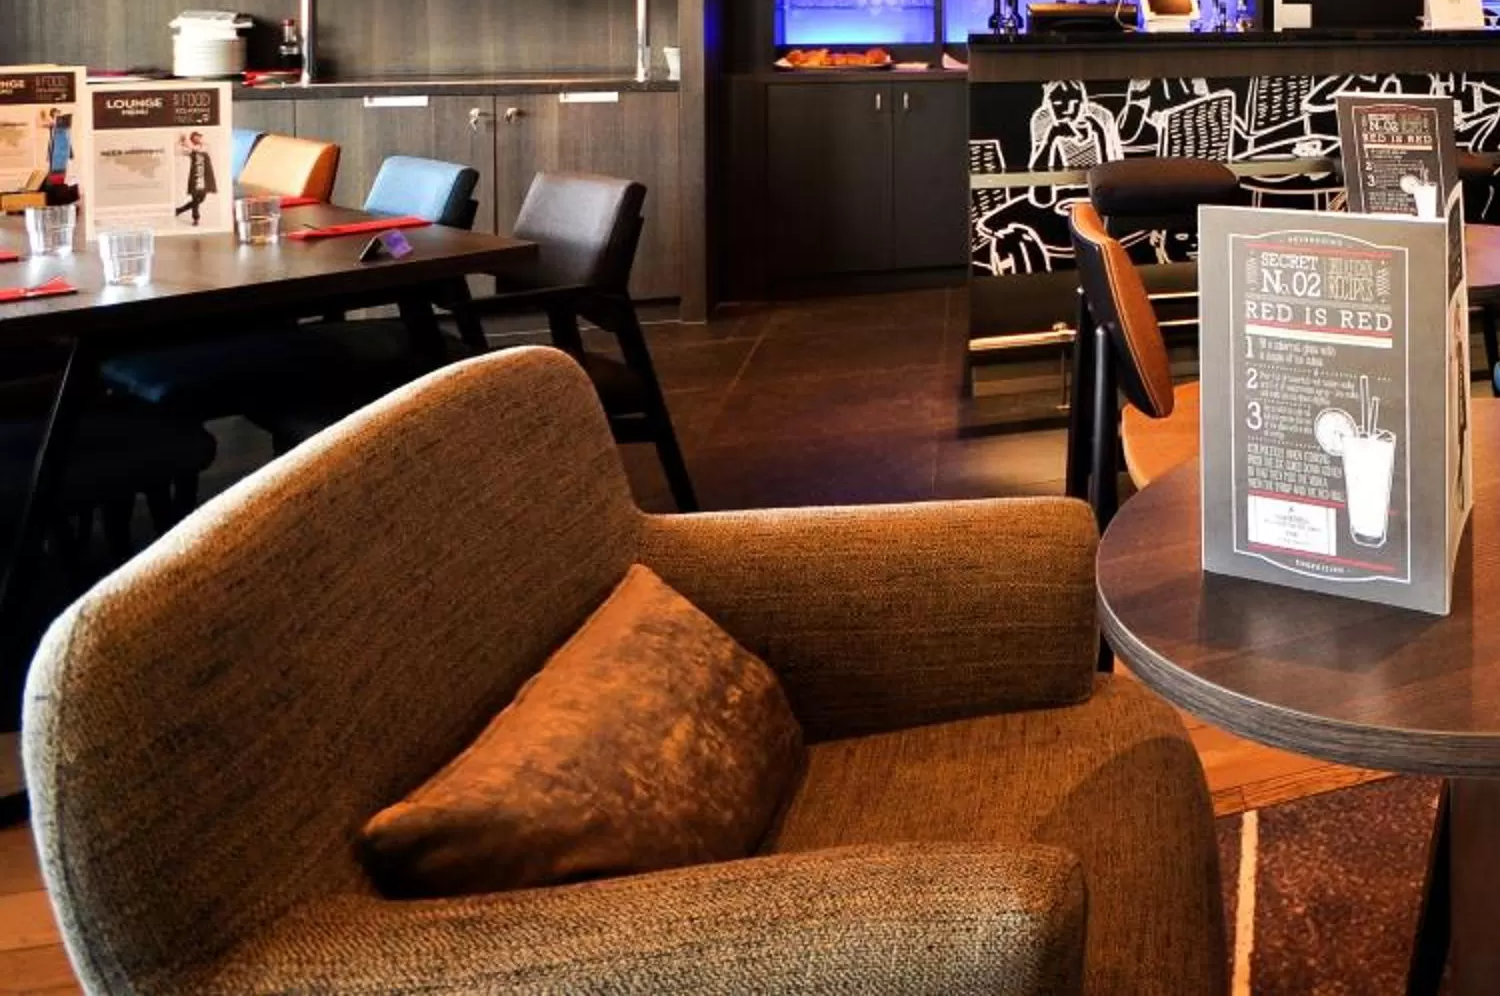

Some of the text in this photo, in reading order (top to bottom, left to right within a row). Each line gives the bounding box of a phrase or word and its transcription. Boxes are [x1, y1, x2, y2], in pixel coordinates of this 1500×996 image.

[105, 97, 163, 109] LOUNGE
[1260, 251, 1319, 271] SECRET
[1245, 300, 1393, 332] RED IS RED
[1245, 335, 1254, 359] 1
[1247, 367, 1258, 389] 2
[1247, 401, 1262, 430] 3
